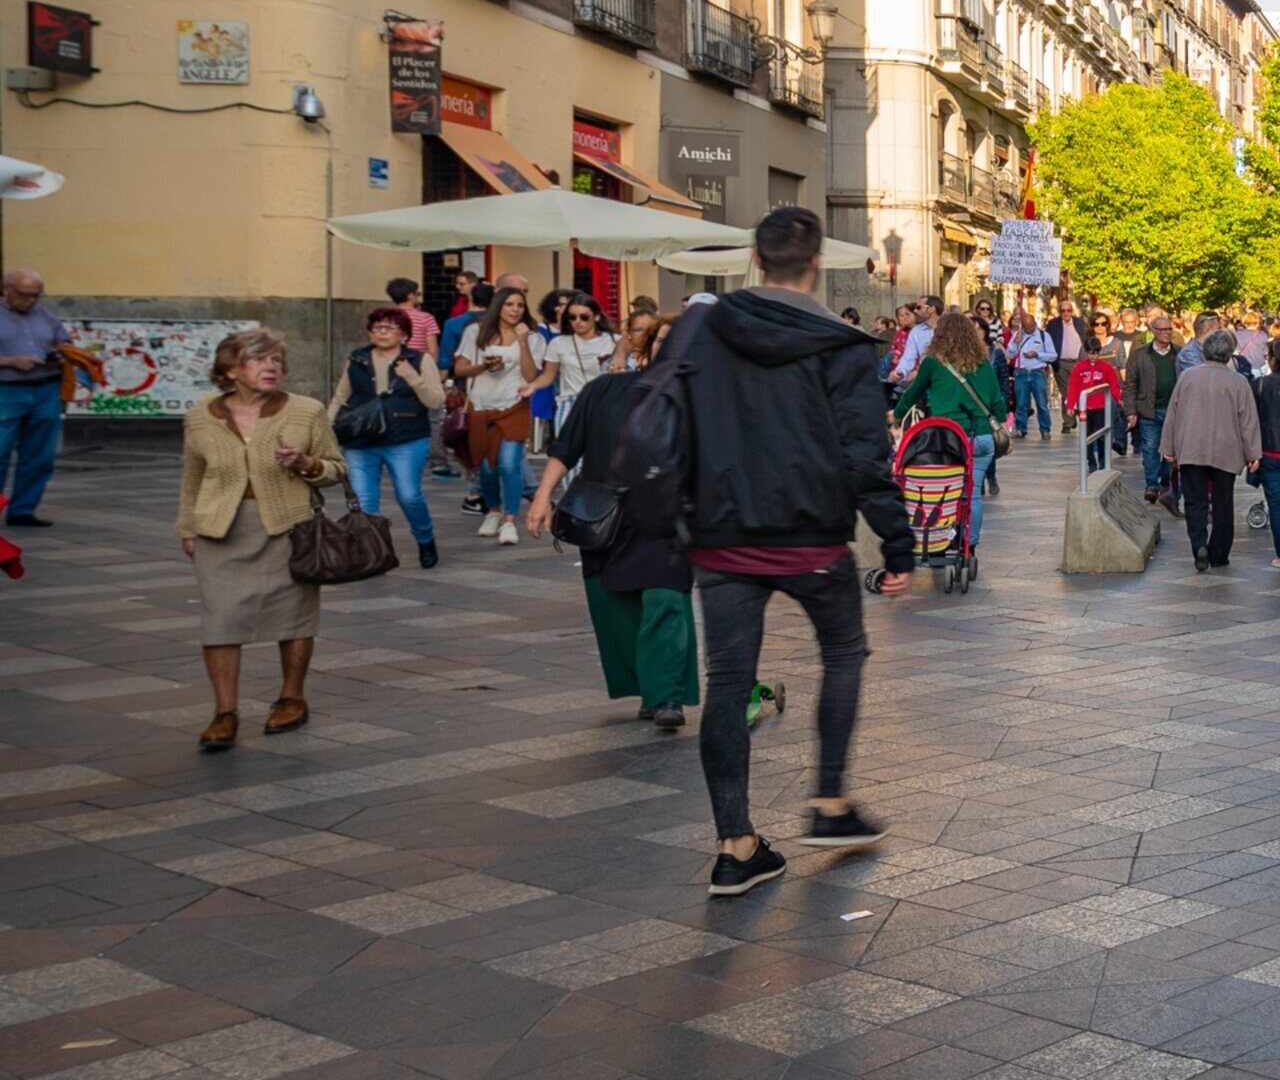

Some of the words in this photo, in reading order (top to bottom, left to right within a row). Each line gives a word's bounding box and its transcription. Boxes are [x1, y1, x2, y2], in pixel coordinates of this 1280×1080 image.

[392, 55, 402, 68] El
[402, 57, 436, 69] Placer
[398, 67, 413, 79] de
[414, 66, 430, 79] los
[391, 77, 438, 90] Sentidos
[678, 145, 732, 162] Amichi
